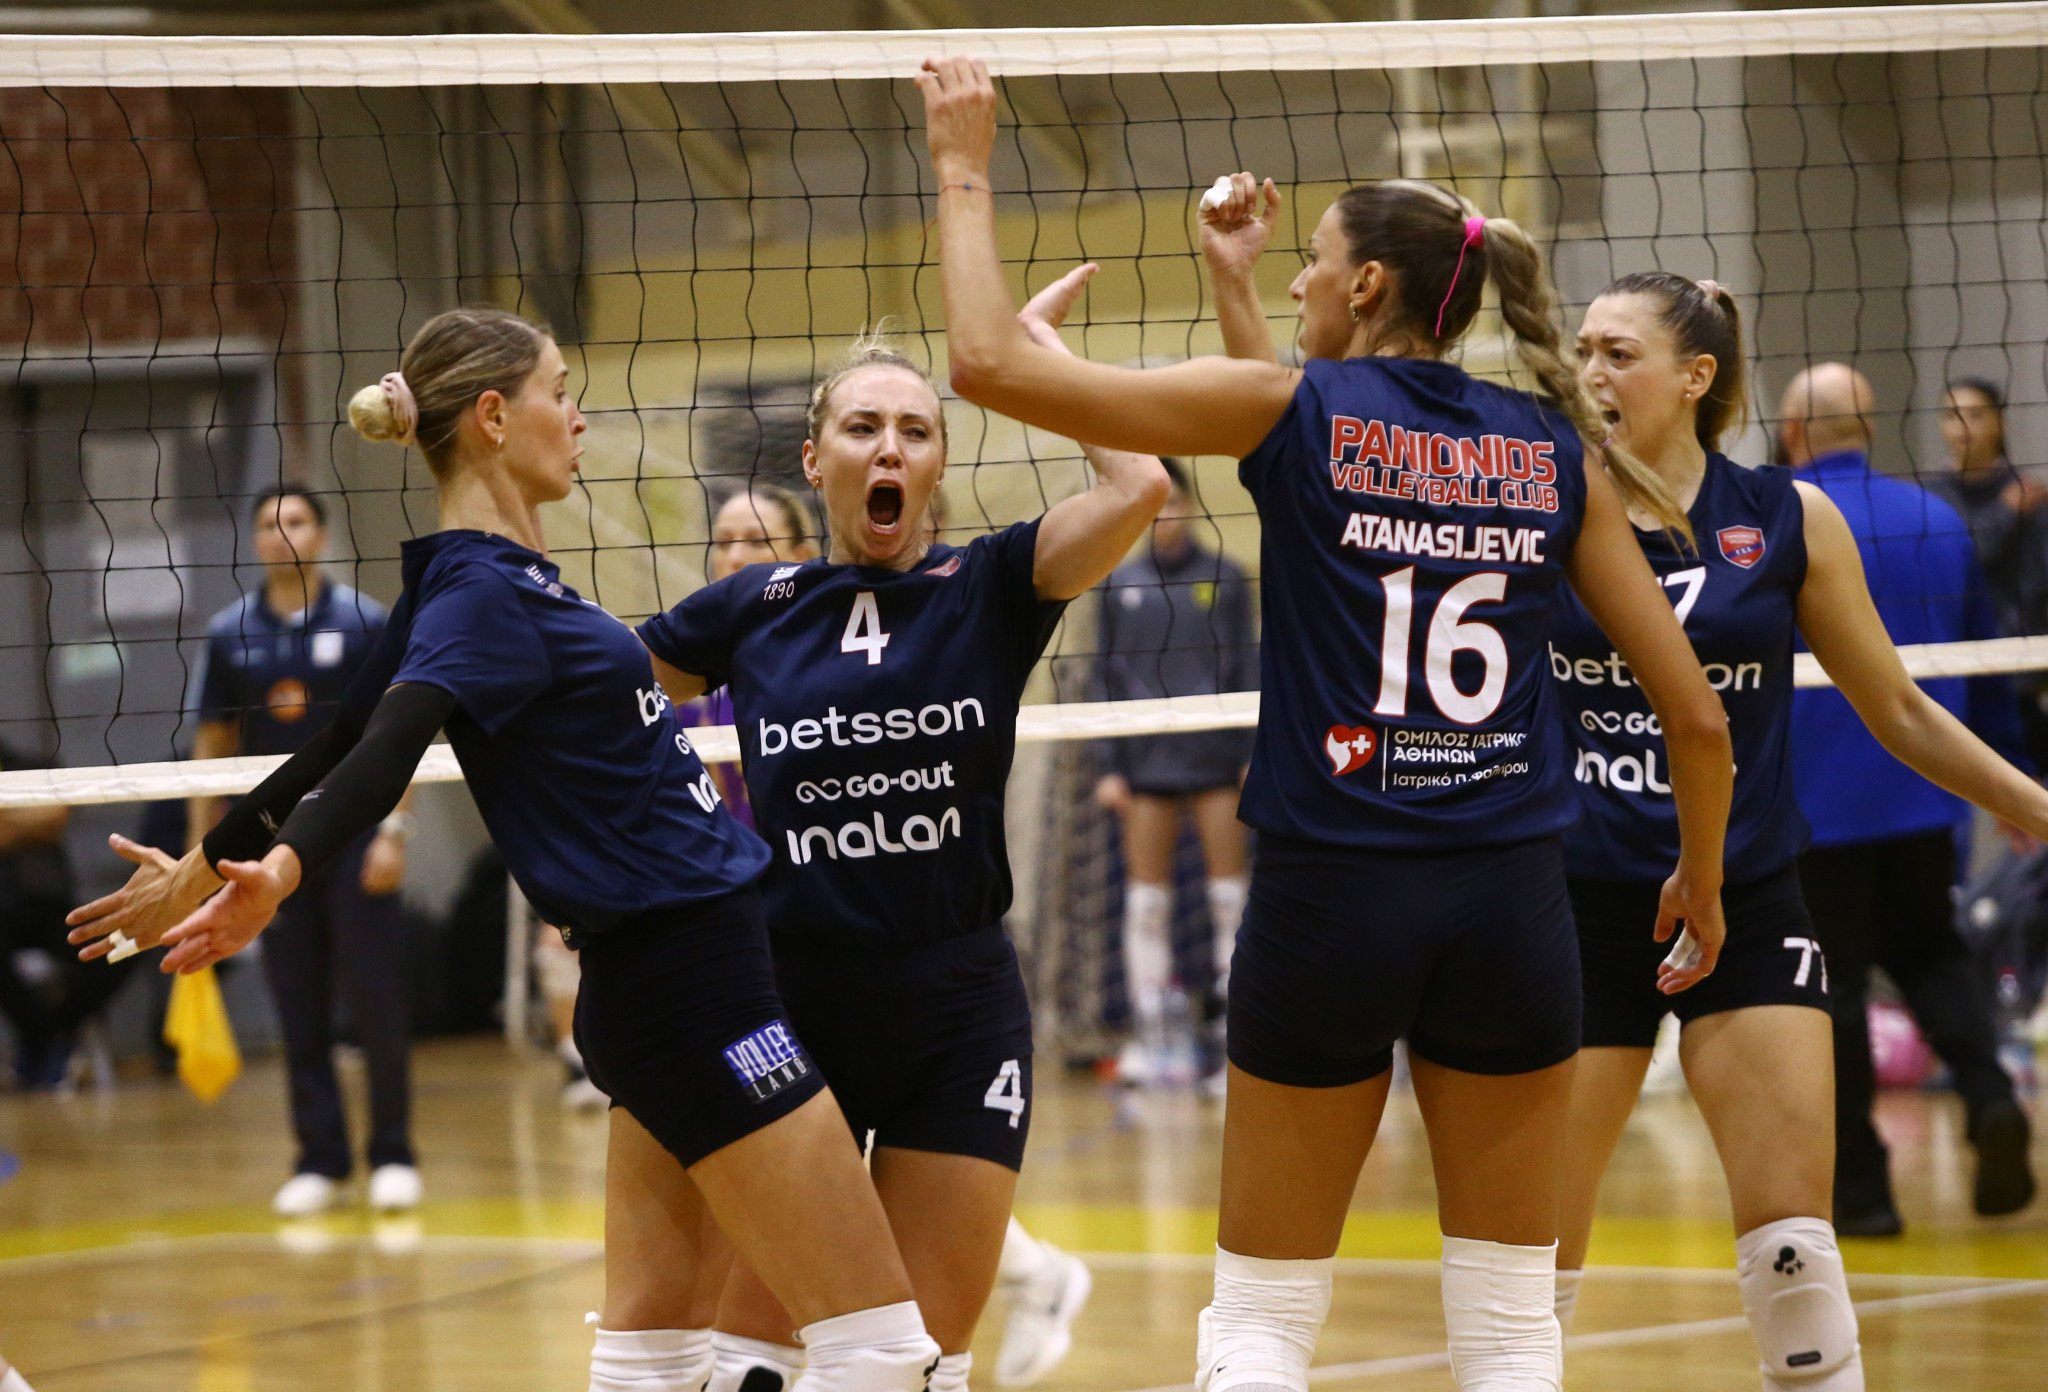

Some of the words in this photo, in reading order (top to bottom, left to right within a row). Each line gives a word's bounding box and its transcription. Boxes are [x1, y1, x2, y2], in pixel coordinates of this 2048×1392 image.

[1331, 415, 1557, 485] PANIONIOS
[1329, 461, 1498, 507] VOLLEYBALL
[1500, 480, 1559, 513] CLUB
[1340, 512, 1546, 563] ATANASIJEVIC
[763, 581, 795, 600] 1890
[1656, 566, 1706, 626] 7
[841, 591, 891, 665] 4
[1372, 565, 1509, 726] 16
[1548, 641, 1763, 691] beton
[759, 697, 985, 757] betsson
[1394, 730, 1469, 747] ΟΜΙΛΟΣ
[726, 1022, 799, 1082] VOLLEY
[752, 1057, 808, 1098] LAND
[984, 1059, 1026, 1130] 4
